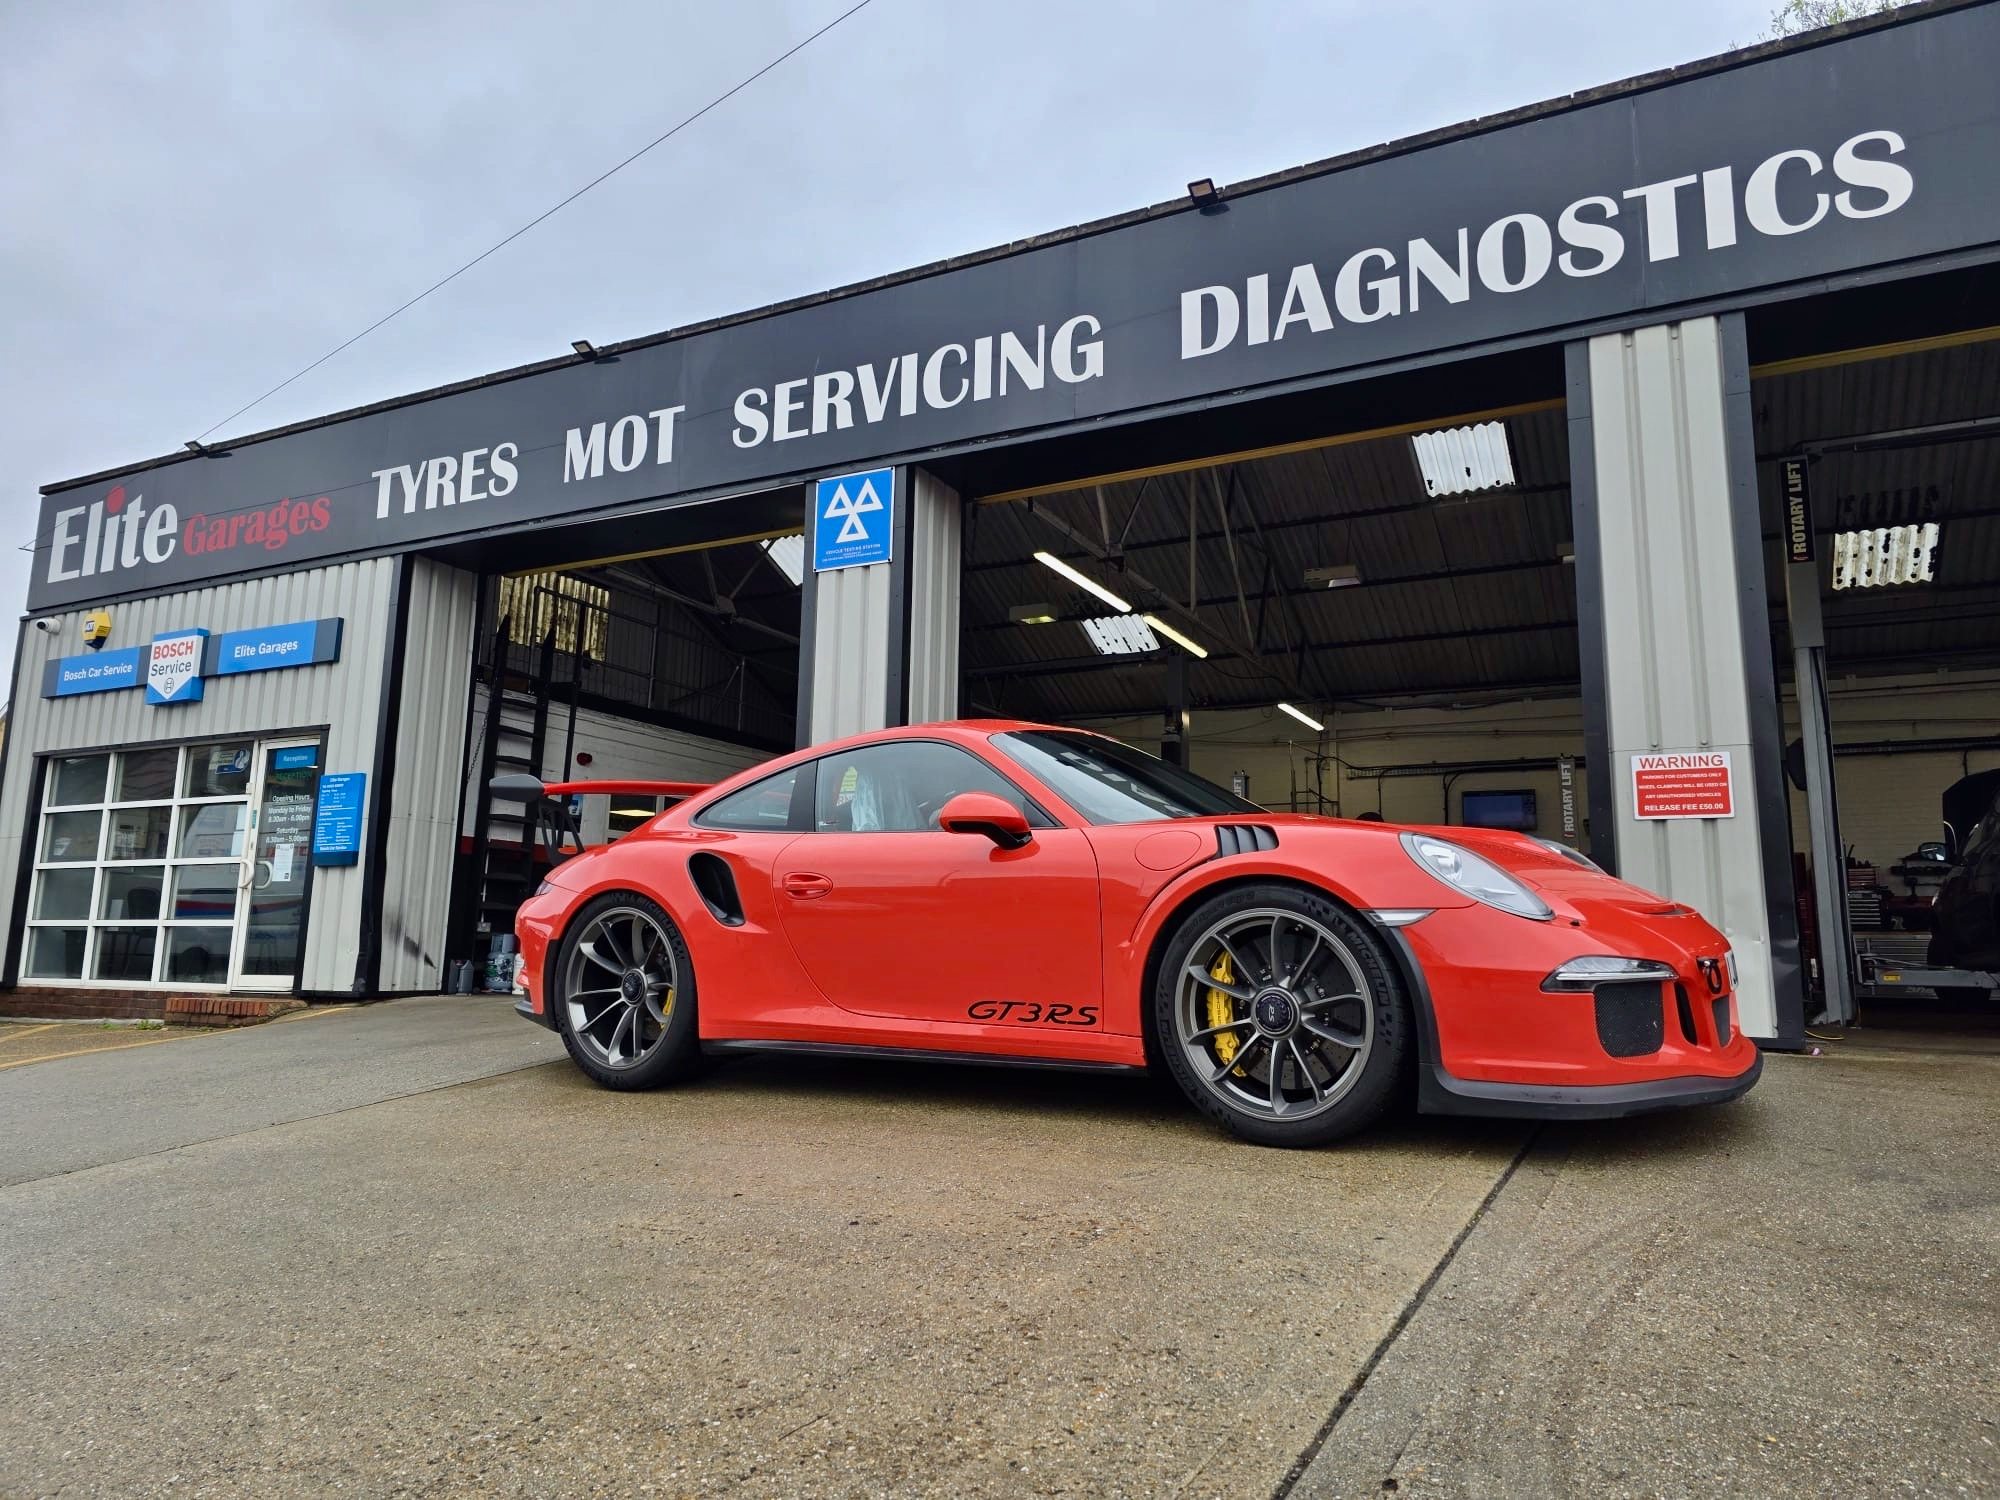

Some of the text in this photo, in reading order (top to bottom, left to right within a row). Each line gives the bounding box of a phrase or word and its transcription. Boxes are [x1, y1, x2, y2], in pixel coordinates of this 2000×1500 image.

[371, 130, 1914, 520] TYRES MOT SERVICING DIAGNOSTICS
[1787, 462, 1807, 554] ROTARY LIFT
[47, 487, 331, 584] Elite Garages
[150, 660, 192, 677] Service
[153, 640, 195, 661] BOSCH
[234, 640, 298, 658] Elite Garages
[64, 663, 133, 681] Bosch Car Service
[1639, 754, 1723, 769] WARNING
[1561, 763, 1574, 832] ROTARY LIFT
[1346, 930, 1392, 1007] MICHELIN
